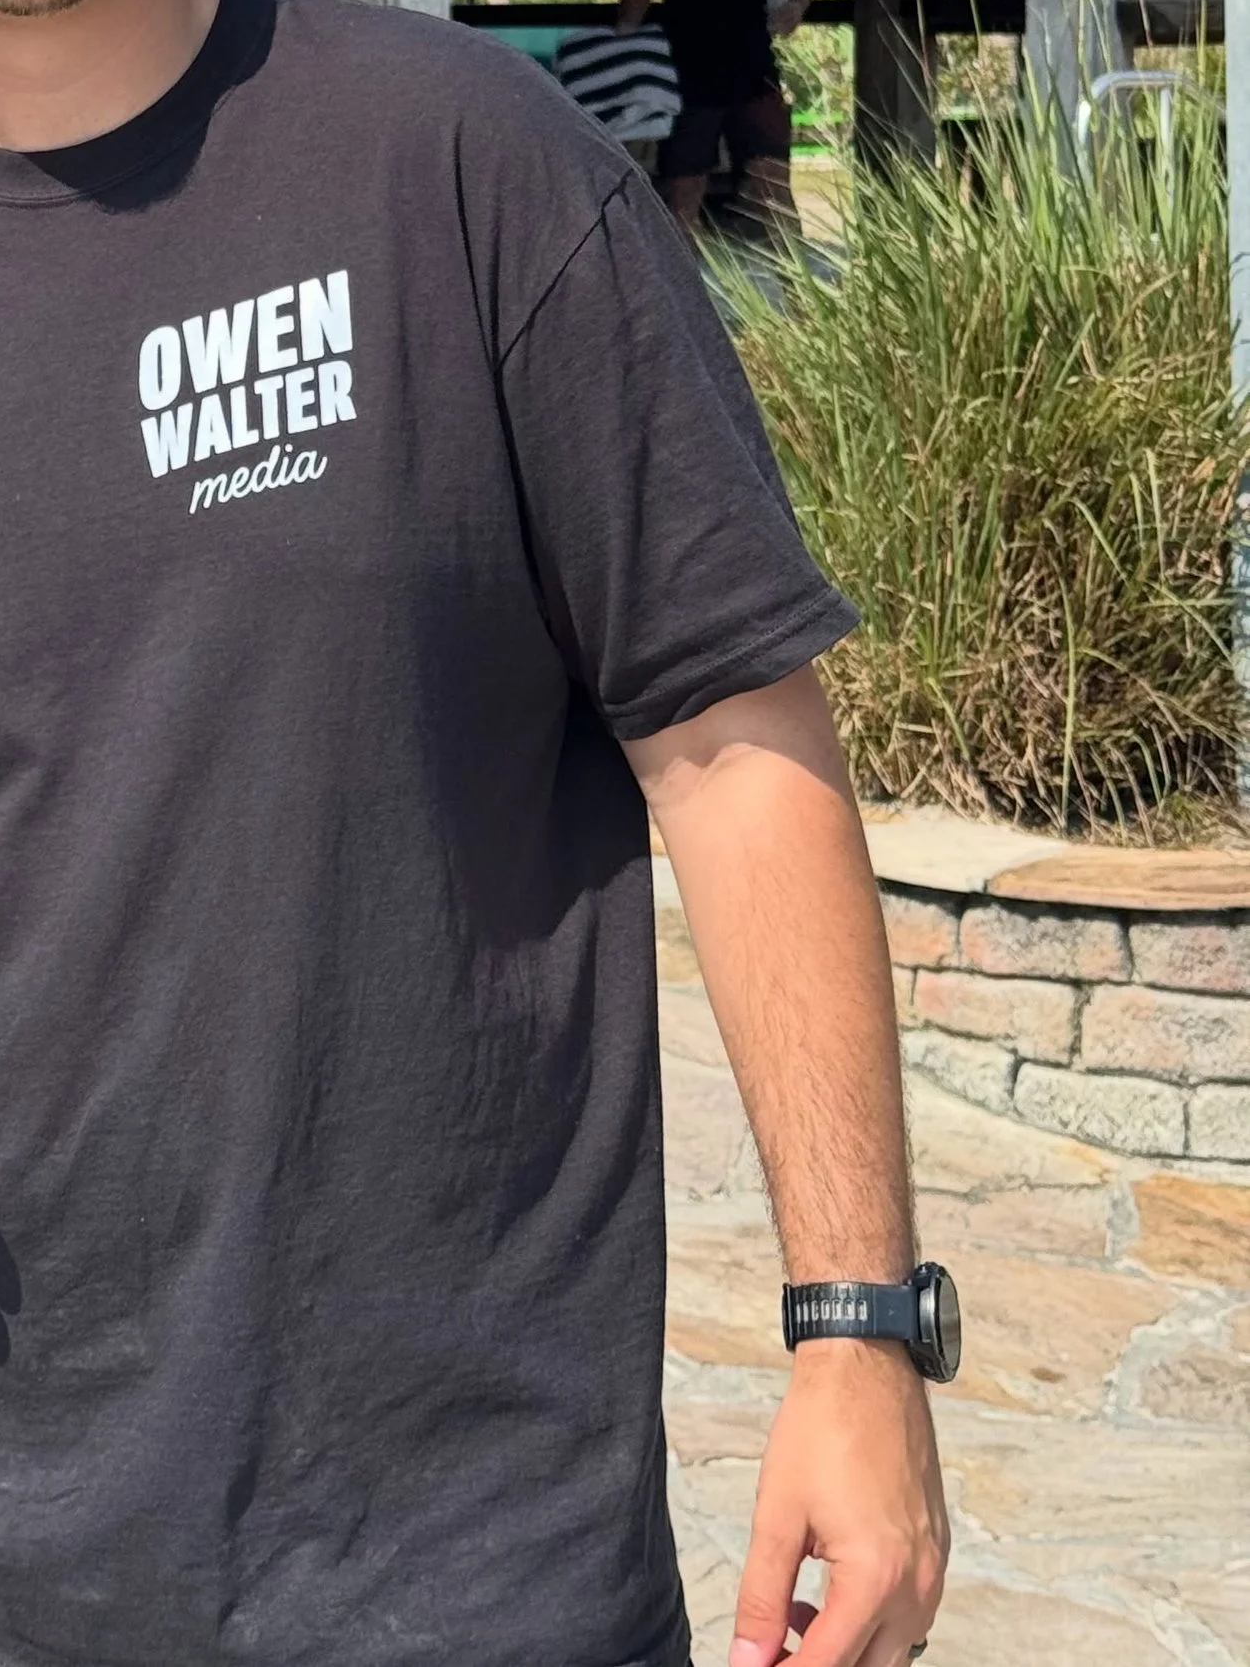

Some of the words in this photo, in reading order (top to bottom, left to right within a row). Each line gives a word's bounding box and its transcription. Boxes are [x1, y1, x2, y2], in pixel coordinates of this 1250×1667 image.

[138, 269, 354, 411] OWEN
[140, 360, 357, 479] WALTER
[188, 444, 328, 514] media
